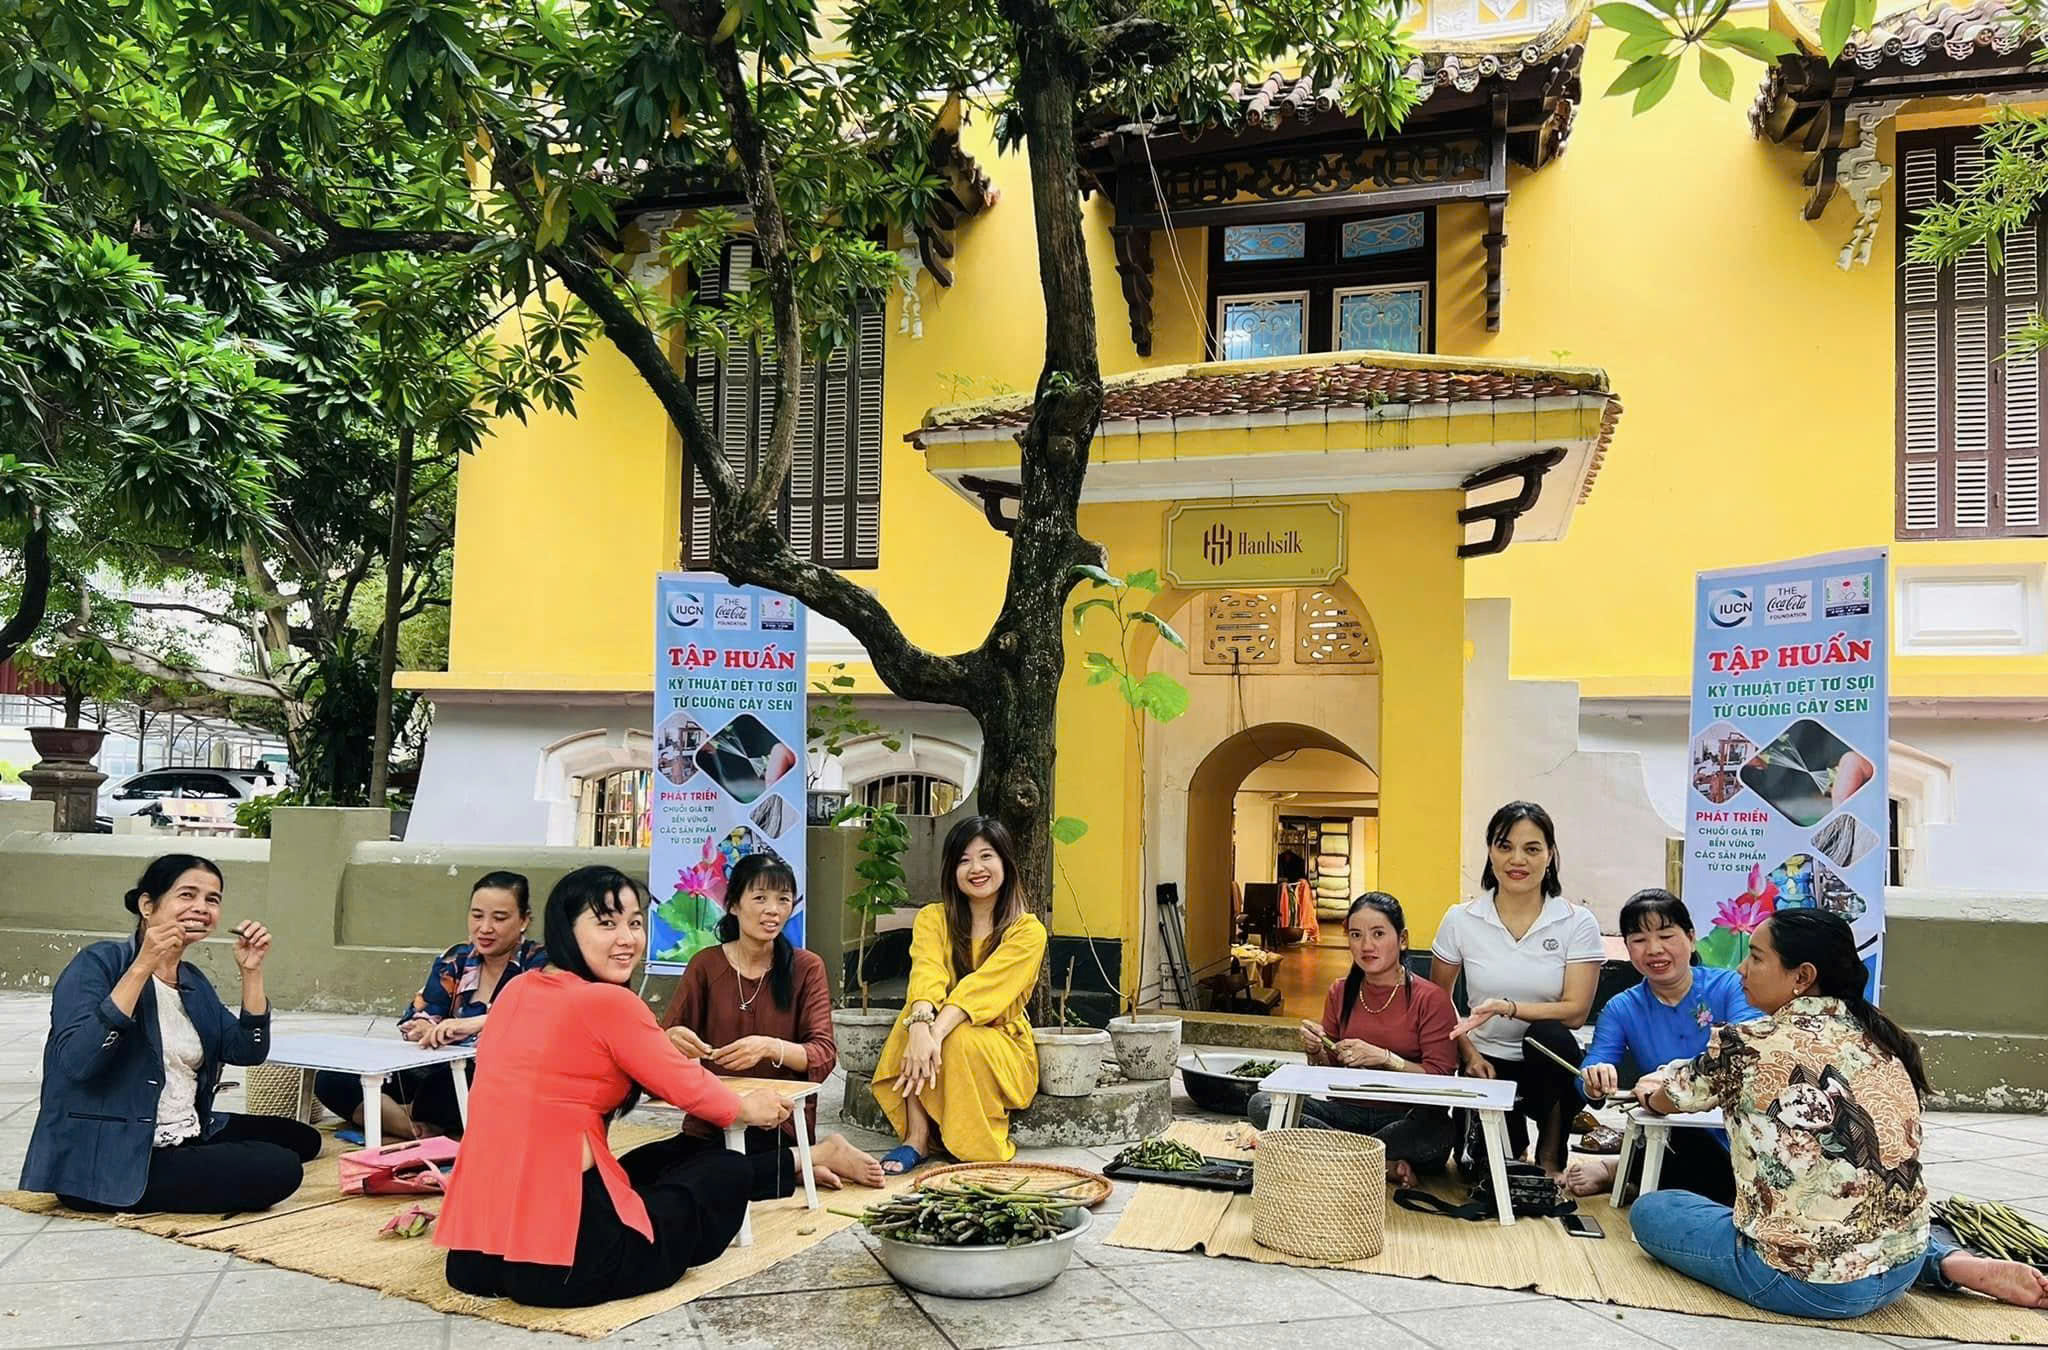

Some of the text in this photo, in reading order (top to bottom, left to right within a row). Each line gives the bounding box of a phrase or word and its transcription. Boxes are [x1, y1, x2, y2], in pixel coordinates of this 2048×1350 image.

[1238, 530, 1303, 555] Hanhsilk
[1778, 586, 1798, 596] THE
[676, 604, 704, 616] IUCN
[724, 598, 740, 606] THE
[1719, 601, 1753, 615] IUCN
[668, 643, 796, 671] TẬP HUẤN
[1708, 632, 1872, 677] TẬP HUẤN
[688, 677, 728, 693] THUẬT
[731, 678, 754, 694] DỆT
[758, 680, 774, 692] TƠ
[776, 681, 797, 694] SỢI
[1732, 680, 1782, 699] THUẬT
[1786, 679, 1817, 696] DỆT
[1820, 677, 1842, 692] TƠ
[1846, 675, 1875, 693] SỢI
[673, 695, 689, 708] TỪ
[739, 697, 763, 710] CÂY
[767, 700, 793, 711] SEN
[1713, 703, 1734, 719] TỪ
[1796, 698, 1829, 715] CÂY
[1834, 698, 1869, 713] SEN
[660, 790, 688, 801] PHÁT
[1695, 809, 1729, 822] PHÁT
